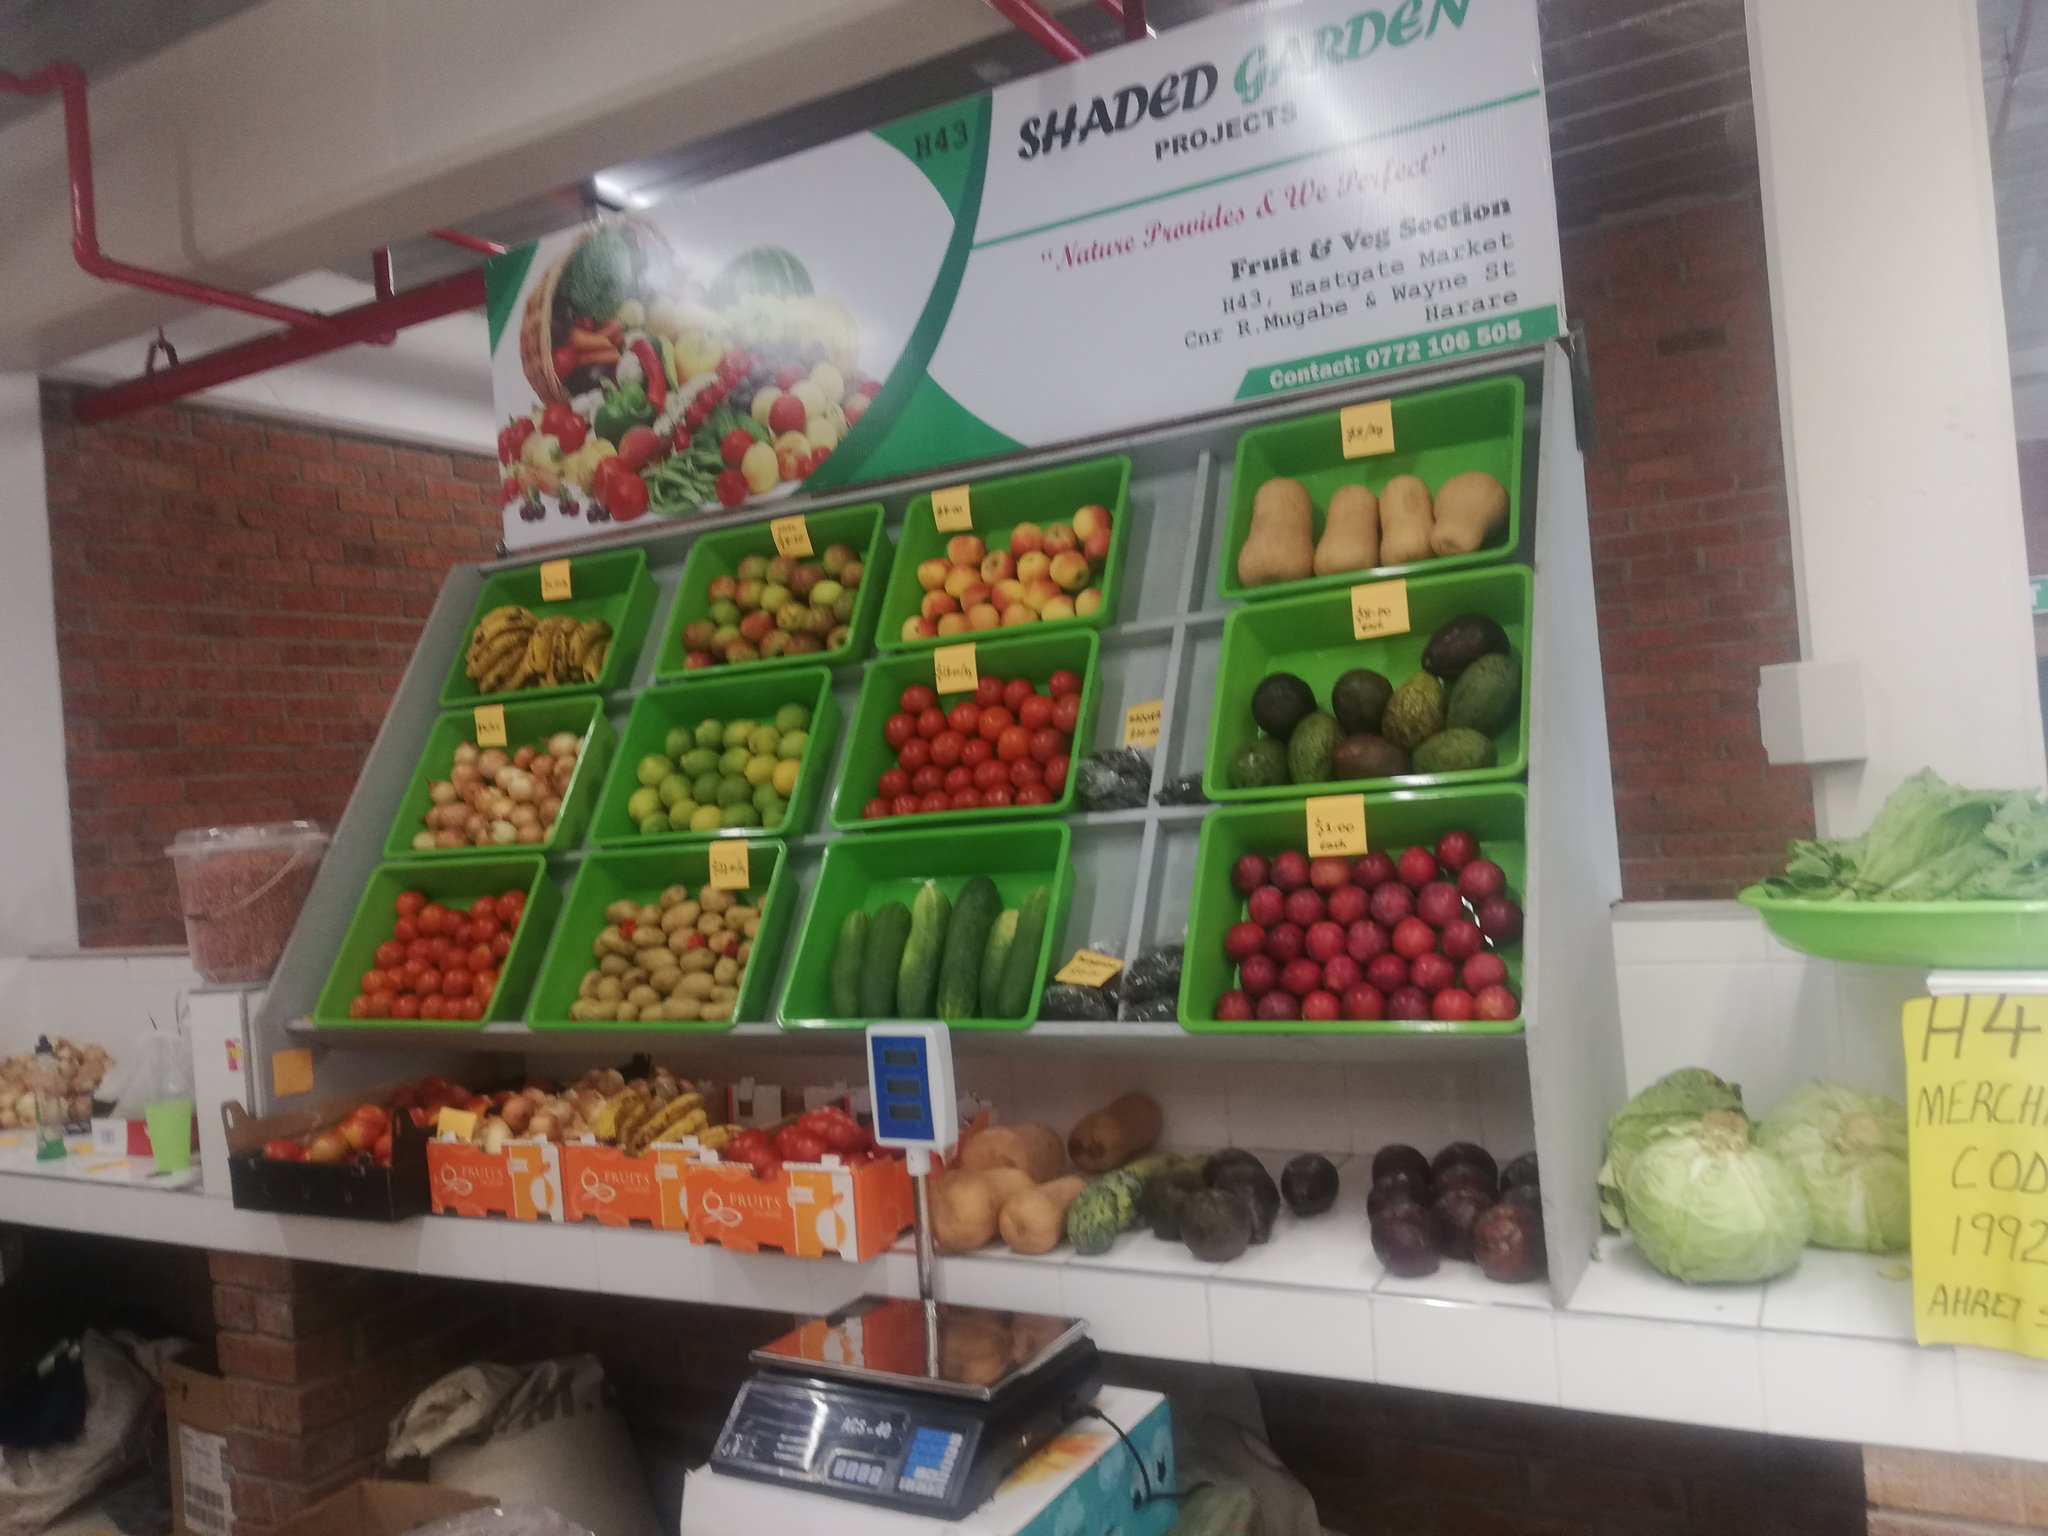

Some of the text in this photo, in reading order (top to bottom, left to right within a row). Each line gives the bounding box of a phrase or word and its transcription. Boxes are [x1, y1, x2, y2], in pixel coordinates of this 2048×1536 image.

[914, 120, 969, 160] H43
[1154, 102, 1298, 161] PROJECTS
[1143, 202, 1245, 248] Provides
[1231, 198, 1511, 281] Fruit & Veg Section
[1222, 231, 1514, 315] H43, Eastgate Market
[1184, 327, 1223, 350] Cnr
[1237, 299, 1348, 338] R.Mugabe
[1391, 273, 1469, 303] Wayne
[1485, 259, 1517, 283] St
[1425, 289, 1519, 323] Harare
[1268, 318, 1523, 391] Contact: 0772 106 505
[1916, 1079, 2048, 1128] MERCH
[461, 1164, 504, 1181] FRUITS
[603, 1169, 650, 1187] FRUITS
[1952, 1145, 2048, 1194] COD
[728, 1191, 783, 1210] FRUITS
[1951, 1211, 2048, 1265] 1992
